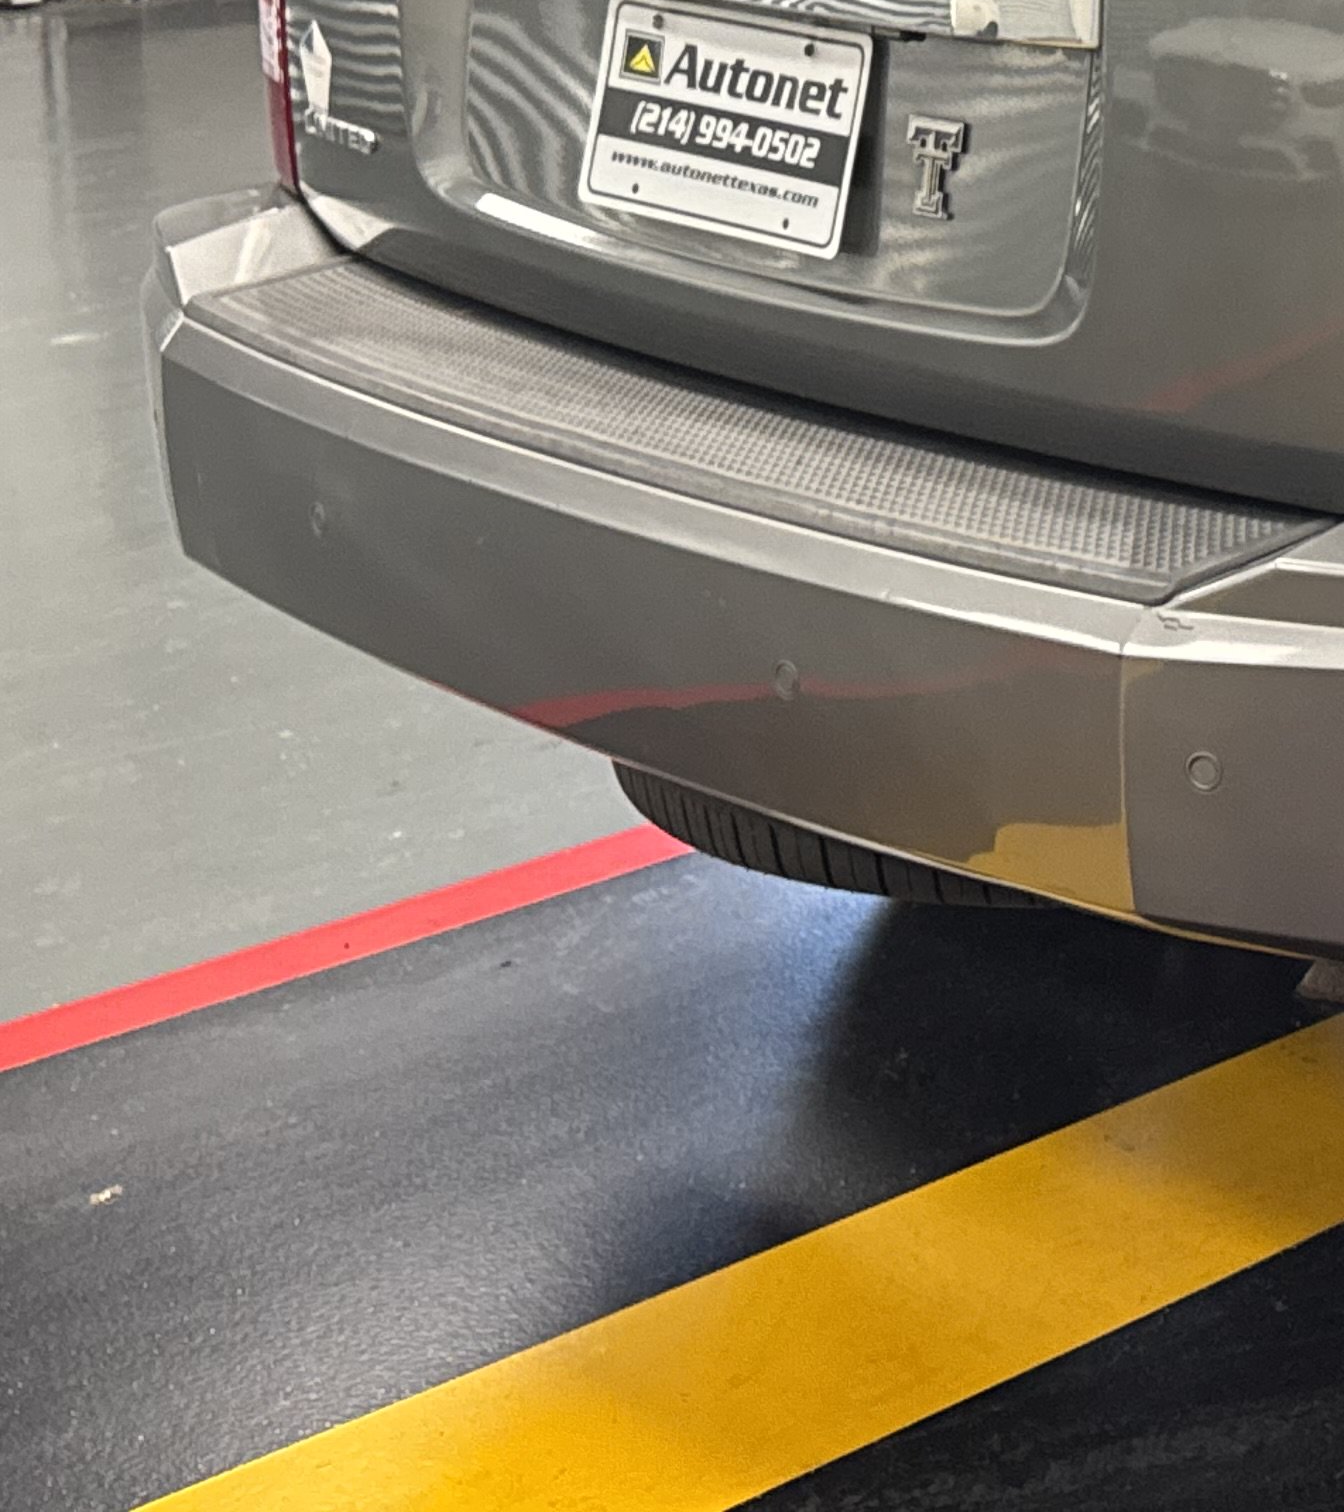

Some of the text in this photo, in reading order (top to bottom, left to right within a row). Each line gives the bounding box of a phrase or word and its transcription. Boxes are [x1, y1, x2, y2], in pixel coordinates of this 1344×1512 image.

[664, 43, 848, 120] Autonet
[630, 100, 821, 169] (214) 994-0502
[610, 149, 820, 209] www.autonettexas.com
